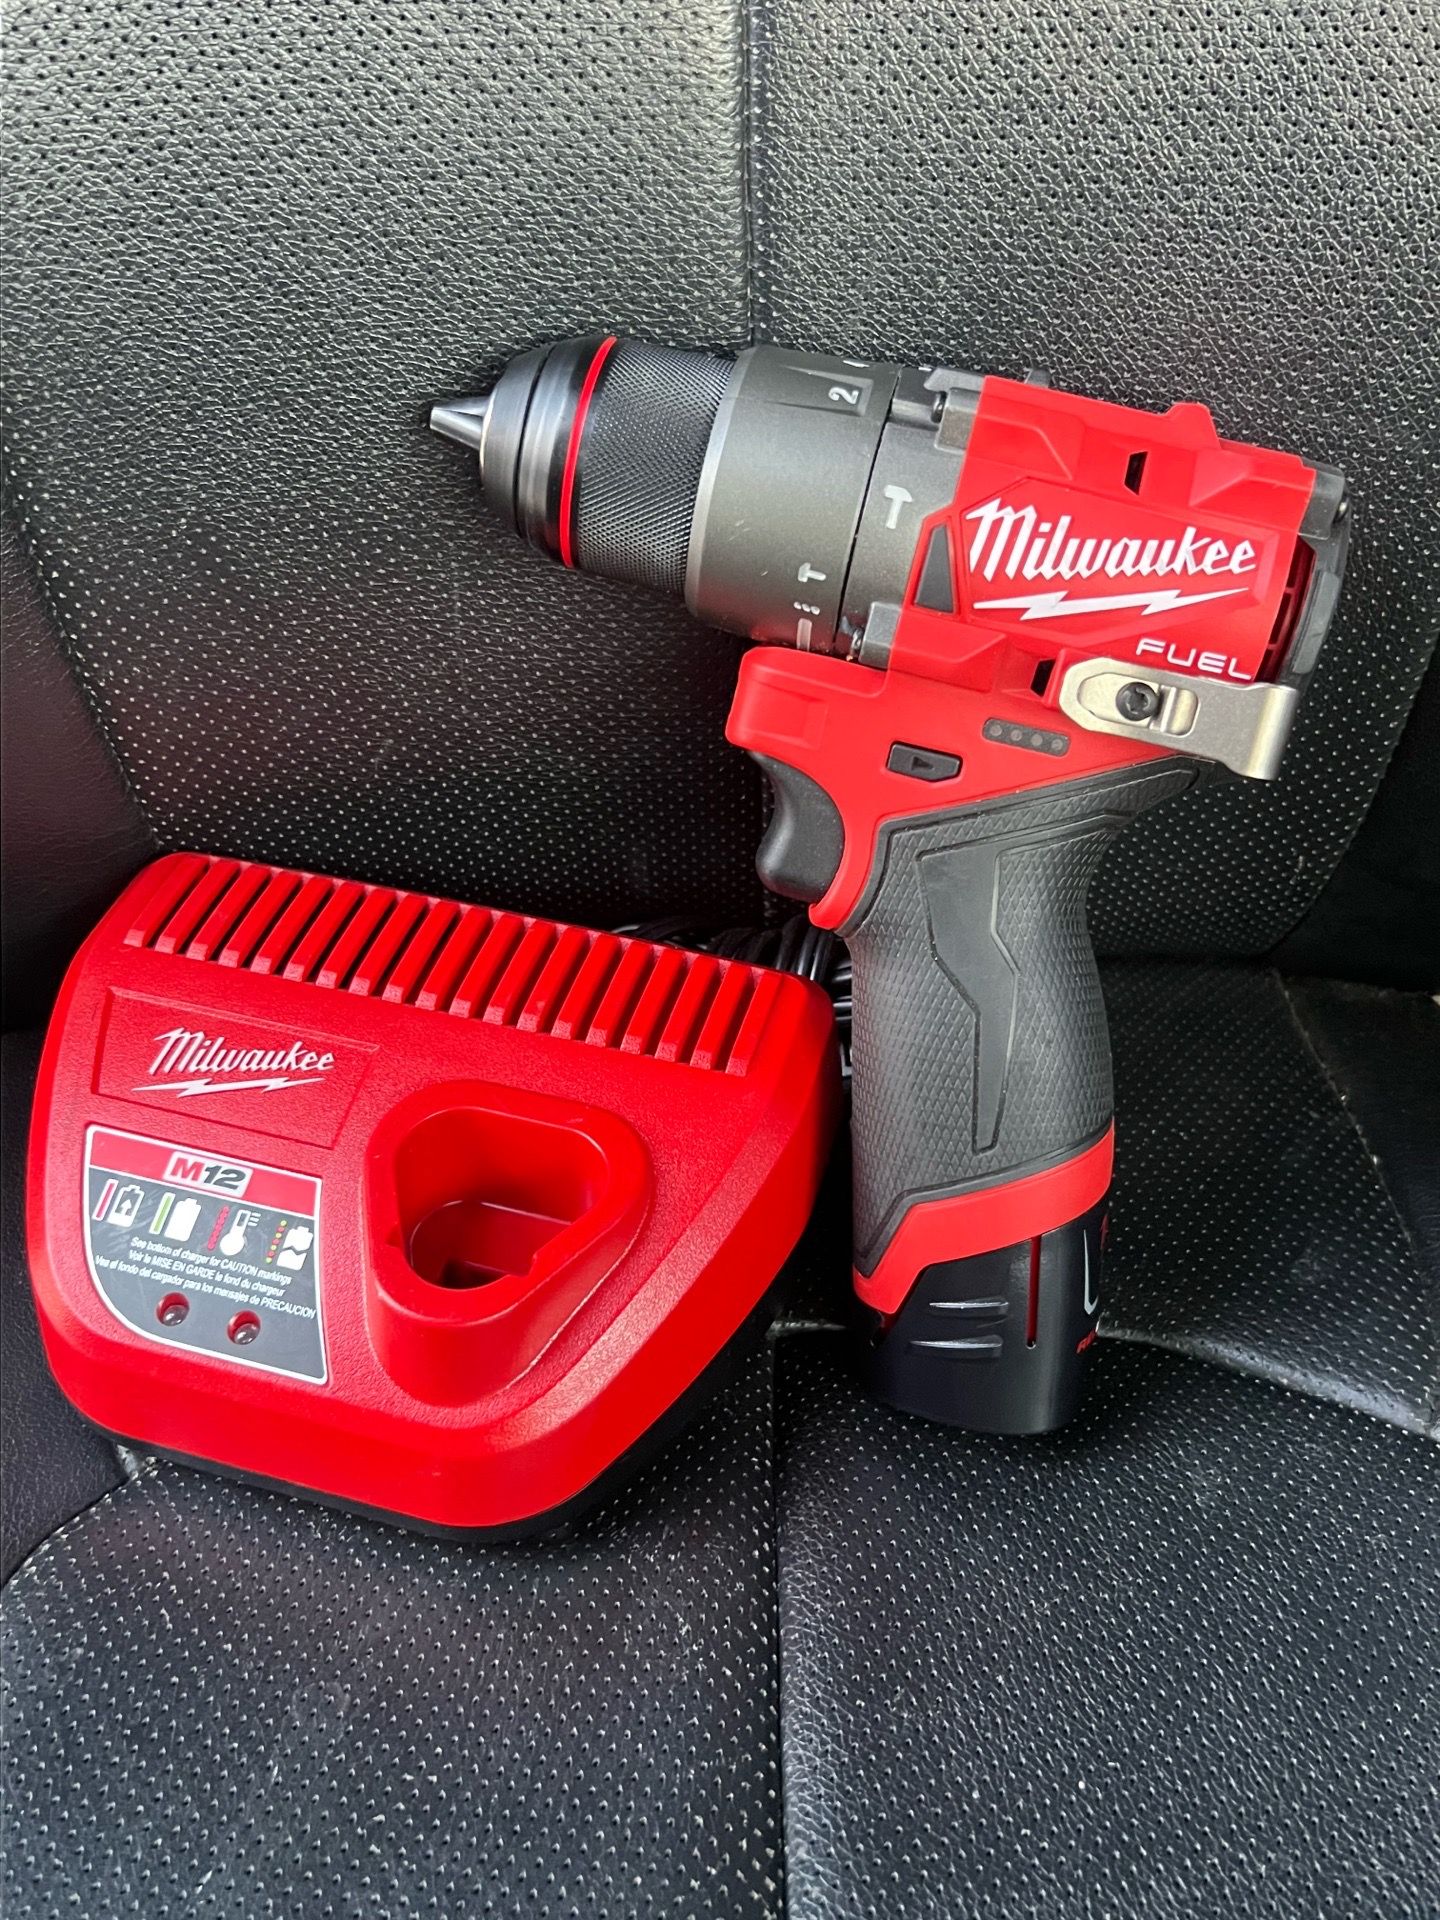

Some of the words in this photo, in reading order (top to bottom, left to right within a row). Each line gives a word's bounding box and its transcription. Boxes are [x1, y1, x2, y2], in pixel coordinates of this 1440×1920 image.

[965, 497, 1257, 582] Milwaukee
[1136, 637, 1252, 680] FUEL
[147, 1027, 335, 1076] Milwaukee
[169, 1156, 246, 1190] M12
[95, 1254, 110, 1267] Vea
[117, 1261, 139, 1275] fondo
[139, 1267, 152, 1277] del
[151, 1271, 185, 1285] cargador
[182, 1280, 201, 1291] para
[201, 1282, 213, 1293] los
[213, 1287, 250, 1302] mensajes
[249, 1295, 260, 1305] de
[129, 1249, 144, 1261] Voir
[151, 1255, 173, 1269] MISE
[171, 1260, 186, 1272] EN
[185, 1264, 216, 1279] GARDE
[223, 1273, 241, 1286] fond
[240, 1279, 251, 1289] du
[251, 1281, 286, 1297] chargeur
[131, 1236, 147, 1249] See
[146, 1241, 172, 1255] bottom
[172, 1247, 183, 1257] of
[180, 1250, 210, 1264] charger
[209, 1256, 221, 1266] for
[220, 1259, 258, 1276] CAUTION
[257, 1269, 292, 1286] markings
